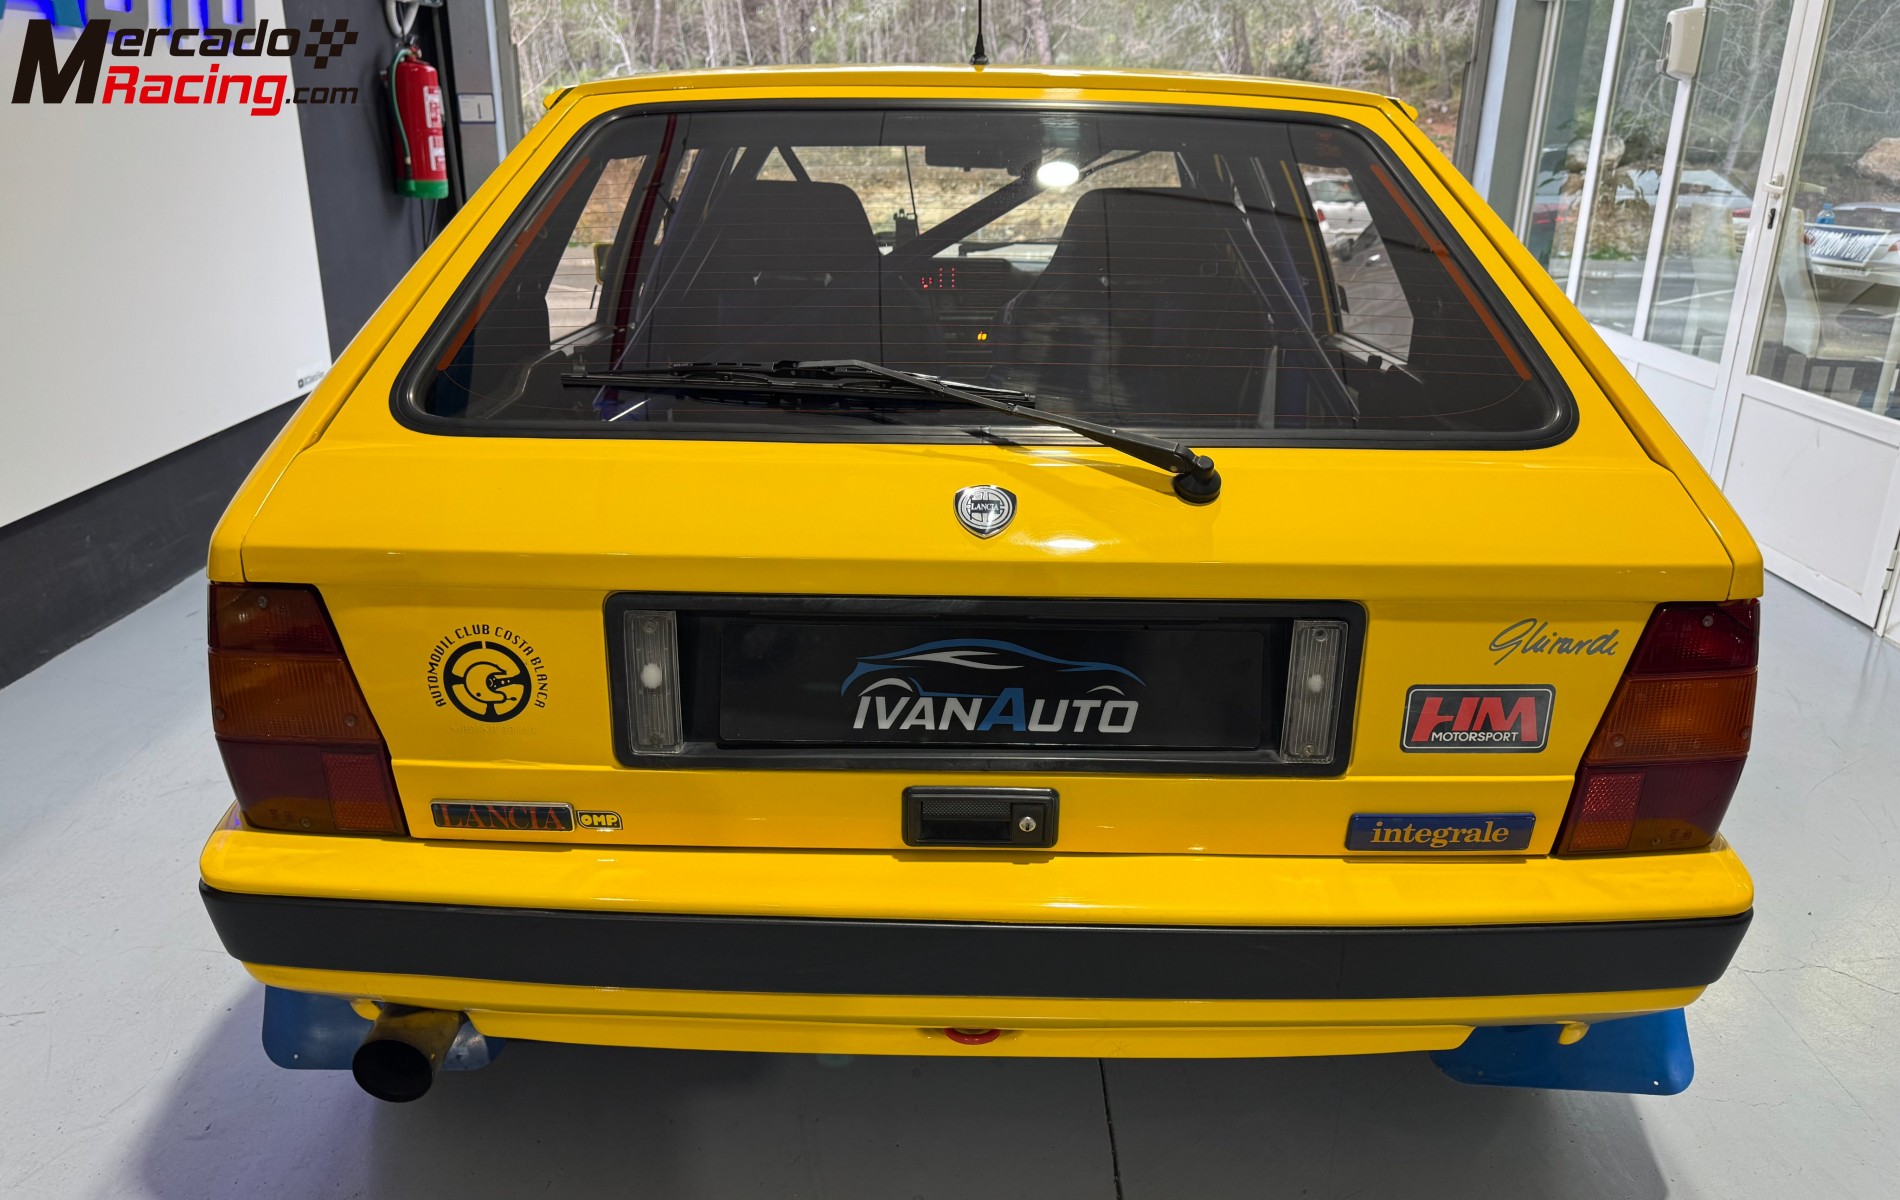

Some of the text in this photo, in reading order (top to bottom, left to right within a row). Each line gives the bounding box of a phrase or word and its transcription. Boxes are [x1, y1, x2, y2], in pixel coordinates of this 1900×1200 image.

[971, 502, 999, 511] LANCIA
[454, 624, 490, 640] CLUB
[494, 626, 534, 656] COSTA
[530, 656, 549, 709] BLANCA
[1411, 696, 1538, 742] HM
[1431, 731, 1519, 742] MOTORSPORT
[439, 803, 618, 831] LANCIA OMP
[1370, 821, 1509, 848] integrale
